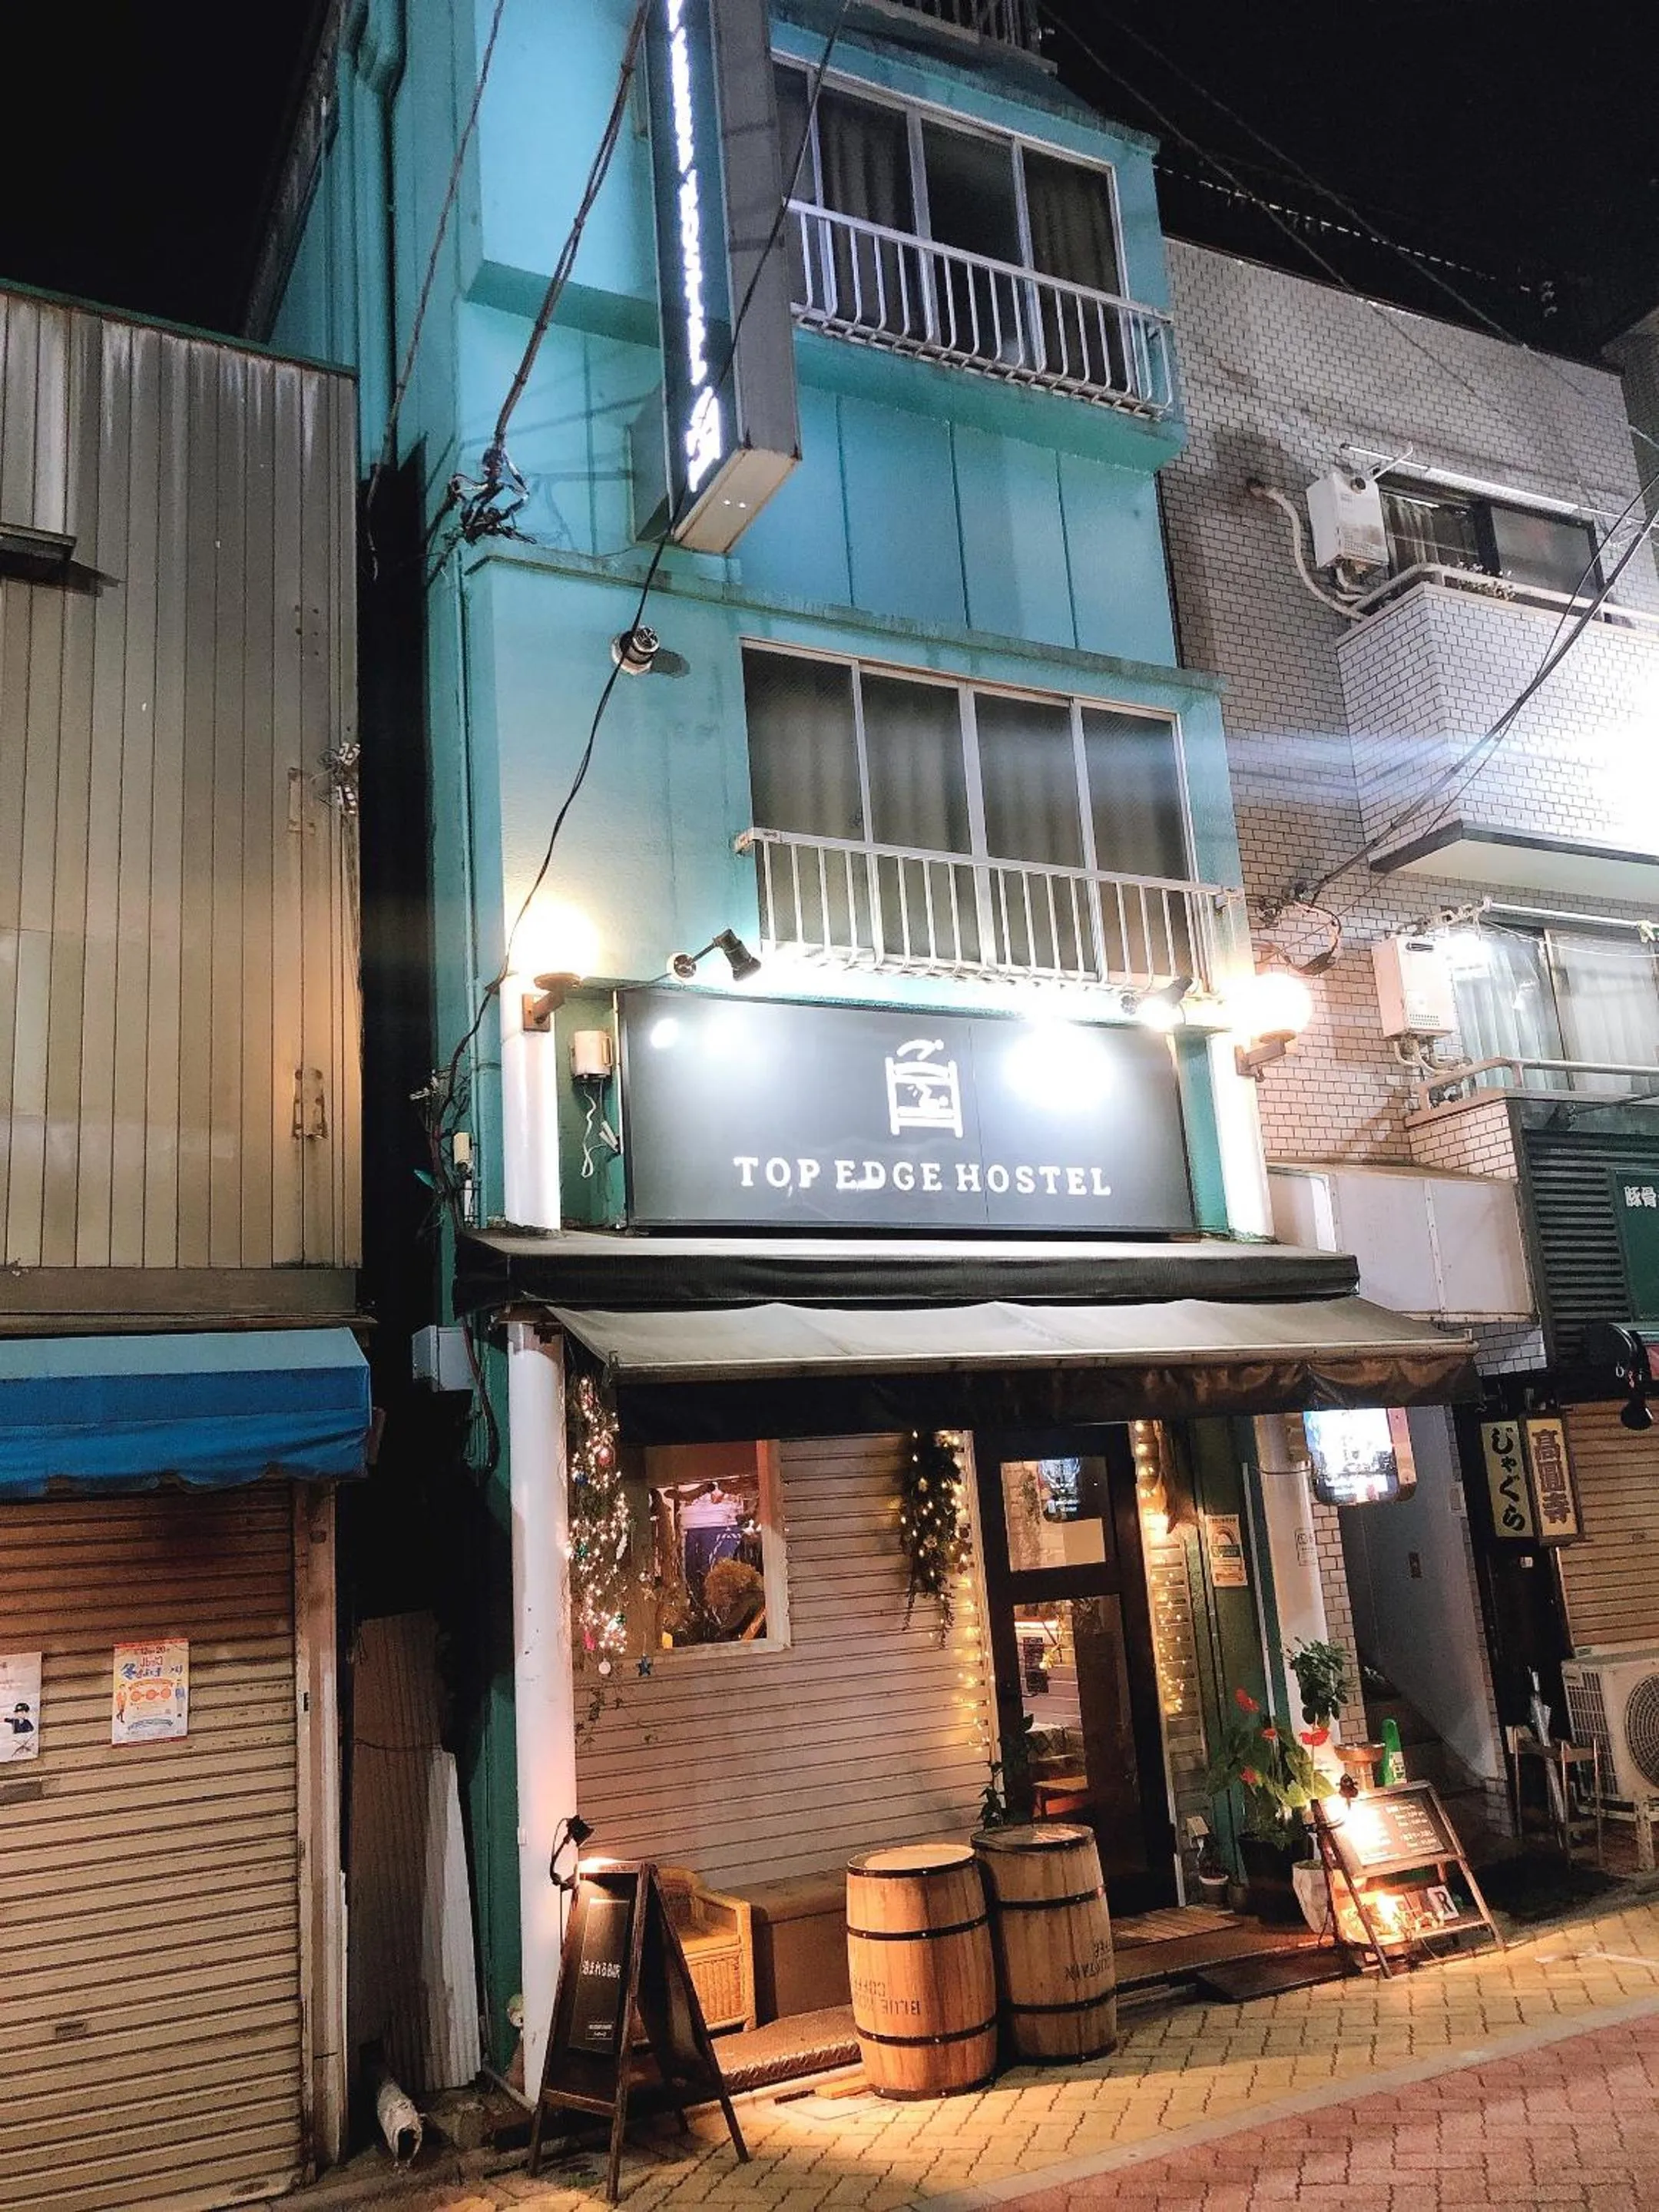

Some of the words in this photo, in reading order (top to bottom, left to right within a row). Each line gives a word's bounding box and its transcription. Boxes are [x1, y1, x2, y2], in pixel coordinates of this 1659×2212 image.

[733, 1157, 820, 1188] TOP
[834, 1160, 942, 1191] EDGE
[955, 1164, 1111, 1196] HOSTEL
[1623, 1186, 1659, 1208] 豚骨
[1492, 1427, 1525, 1532] じゃぐら
